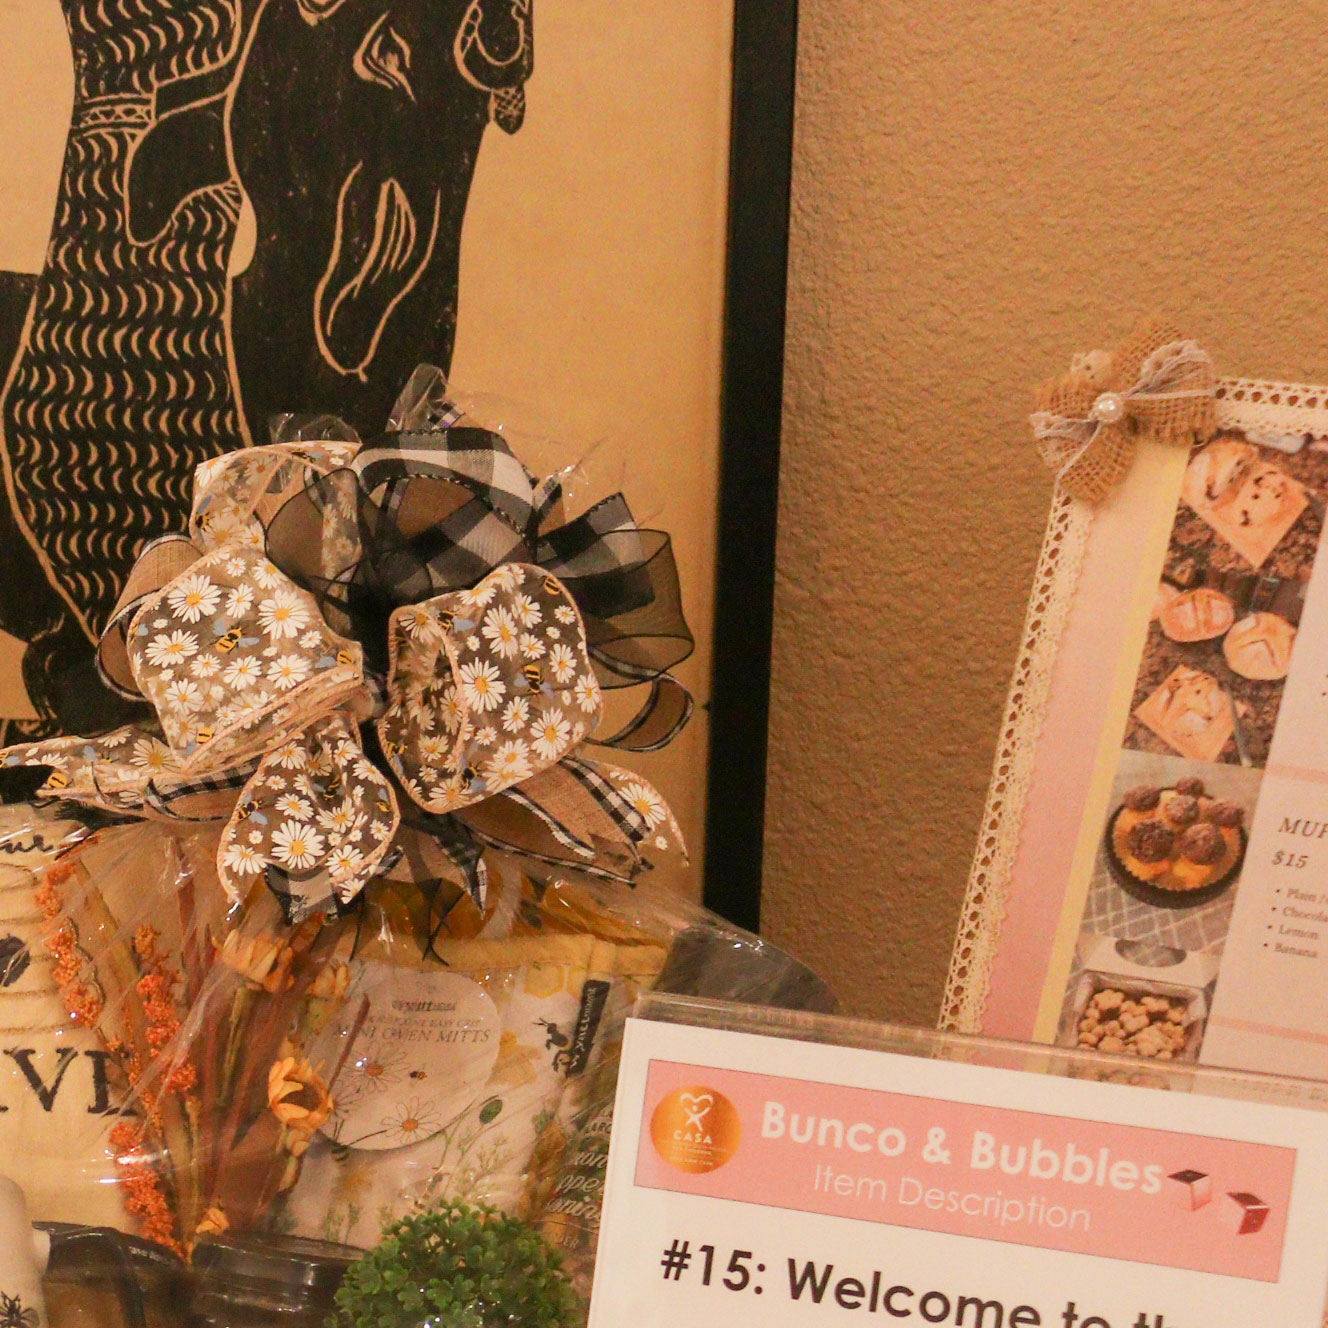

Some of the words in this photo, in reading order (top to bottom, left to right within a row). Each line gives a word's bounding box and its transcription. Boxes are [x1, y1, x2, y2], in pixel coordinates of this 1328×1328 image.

[1272, 850, 1309, 869] $15
[761, 1101, 906, 1159] Bunco
[922, 1127, 951, 1164] &
[971, 1130, 1164, 1195] Bubbles
[814, 1163, 887, 1204] Item
[899, 1177, 1091, 1233] Description
[660, 1239, 766, 1296] #15:
